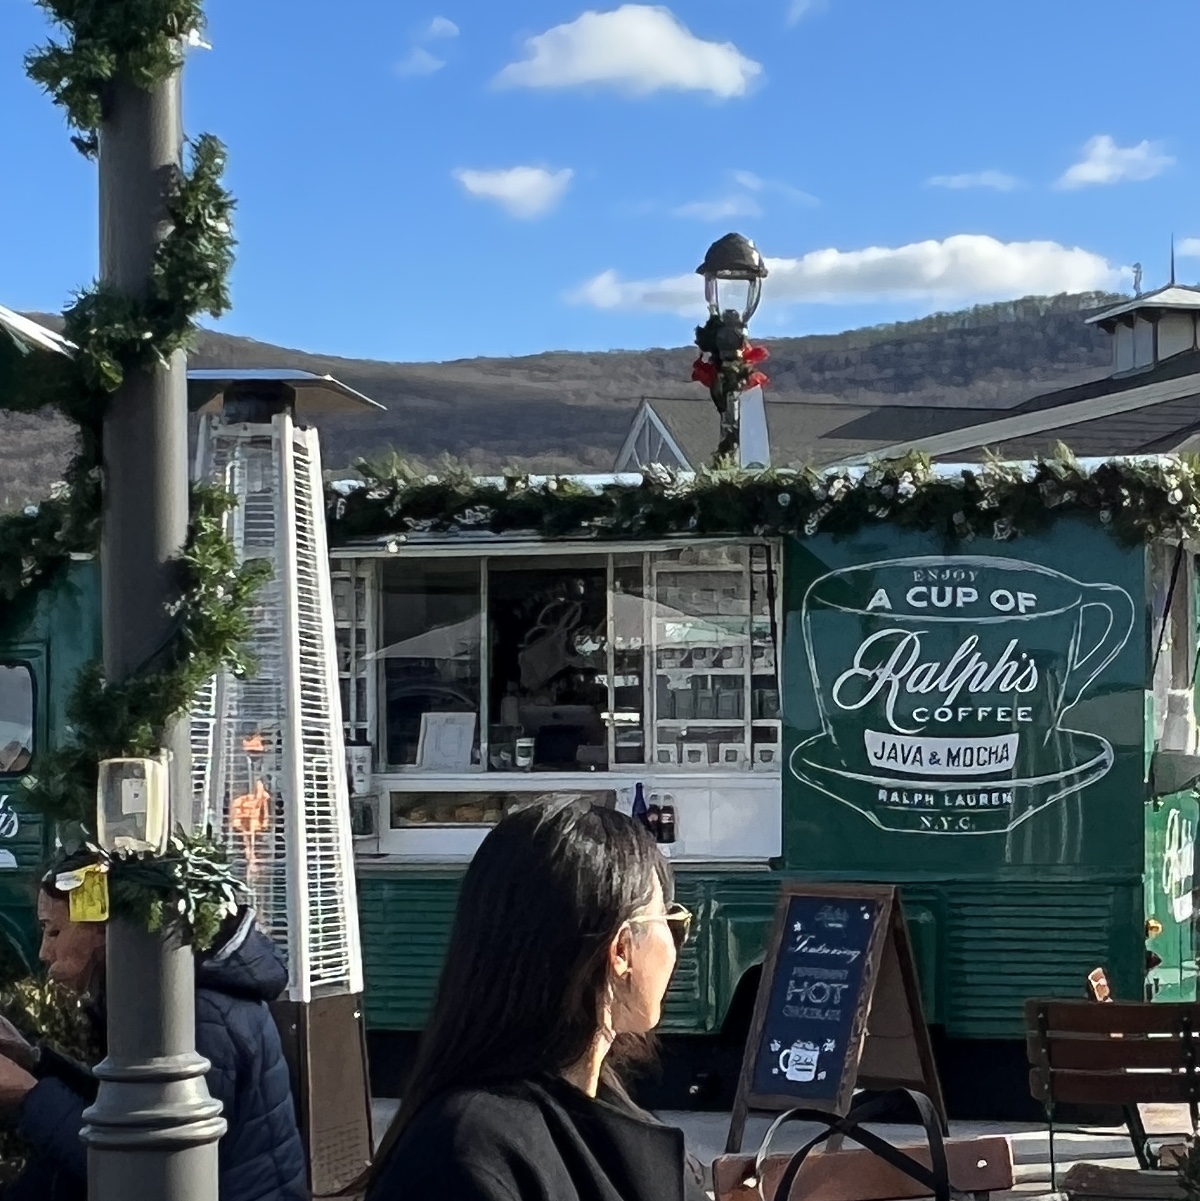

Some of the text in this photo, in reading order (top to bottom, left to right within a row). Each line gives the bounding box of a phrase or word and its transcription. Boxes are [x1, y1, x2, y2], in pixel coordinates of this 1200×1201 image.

[912, 569, 980, 583] ENJOY
[866, 586, 1038, 614] A CUP OF
[832, 628, 1038, 734] Ralph's
[912, 706, 1034, 722] COFFEE
[873, 741, 1010, 768] JAVA & MOCHA
[878, 789, 1014, 807] RALPH LAUREN
[919, 816, 976, 831] N.Y.C.
[786, 979, 849, 1005] HOT
